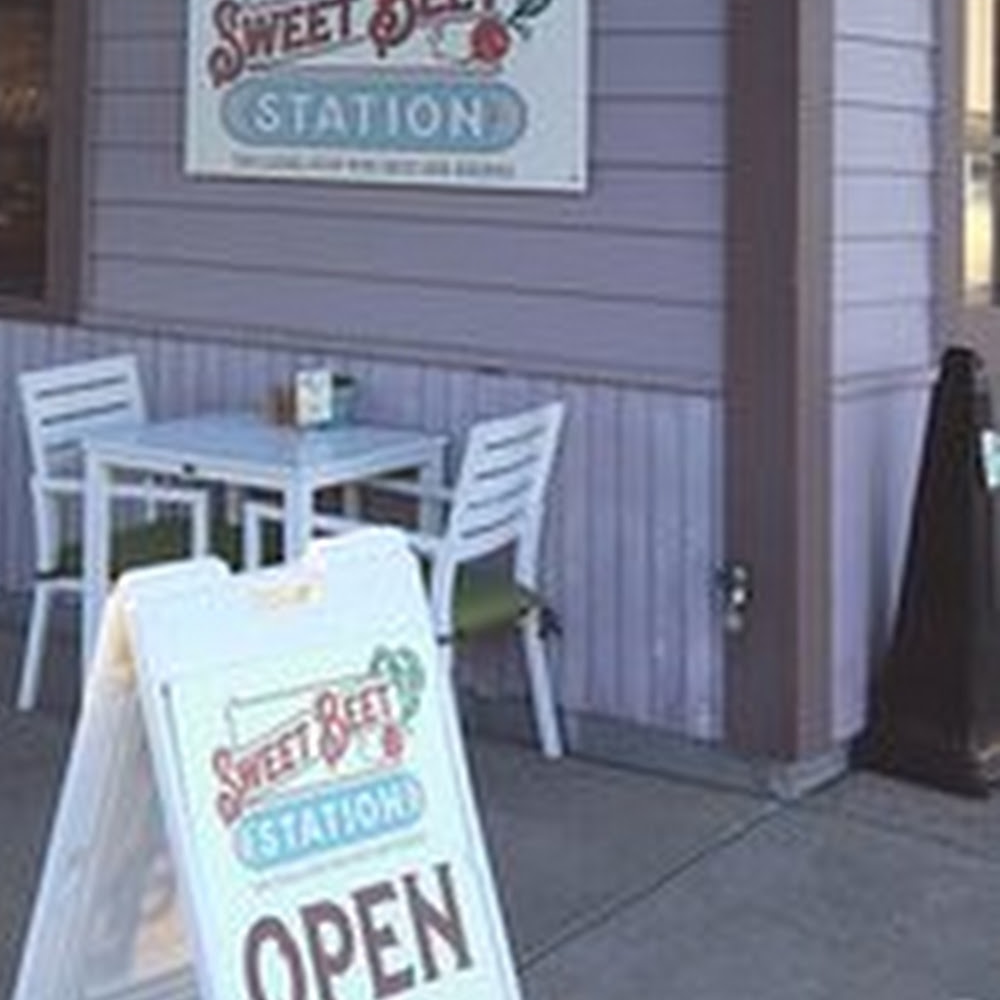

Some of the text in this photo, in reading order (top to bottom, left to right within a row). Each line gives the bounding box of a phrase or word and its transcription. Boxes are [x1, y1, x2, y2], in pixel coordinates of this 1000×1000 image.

[252, 92, 482, 140] STATION
[212, 684, 391, 824] SWEET BEET
[259, 780, 408, 854] STATION
[243, 861, 473, 1000] OPEN
